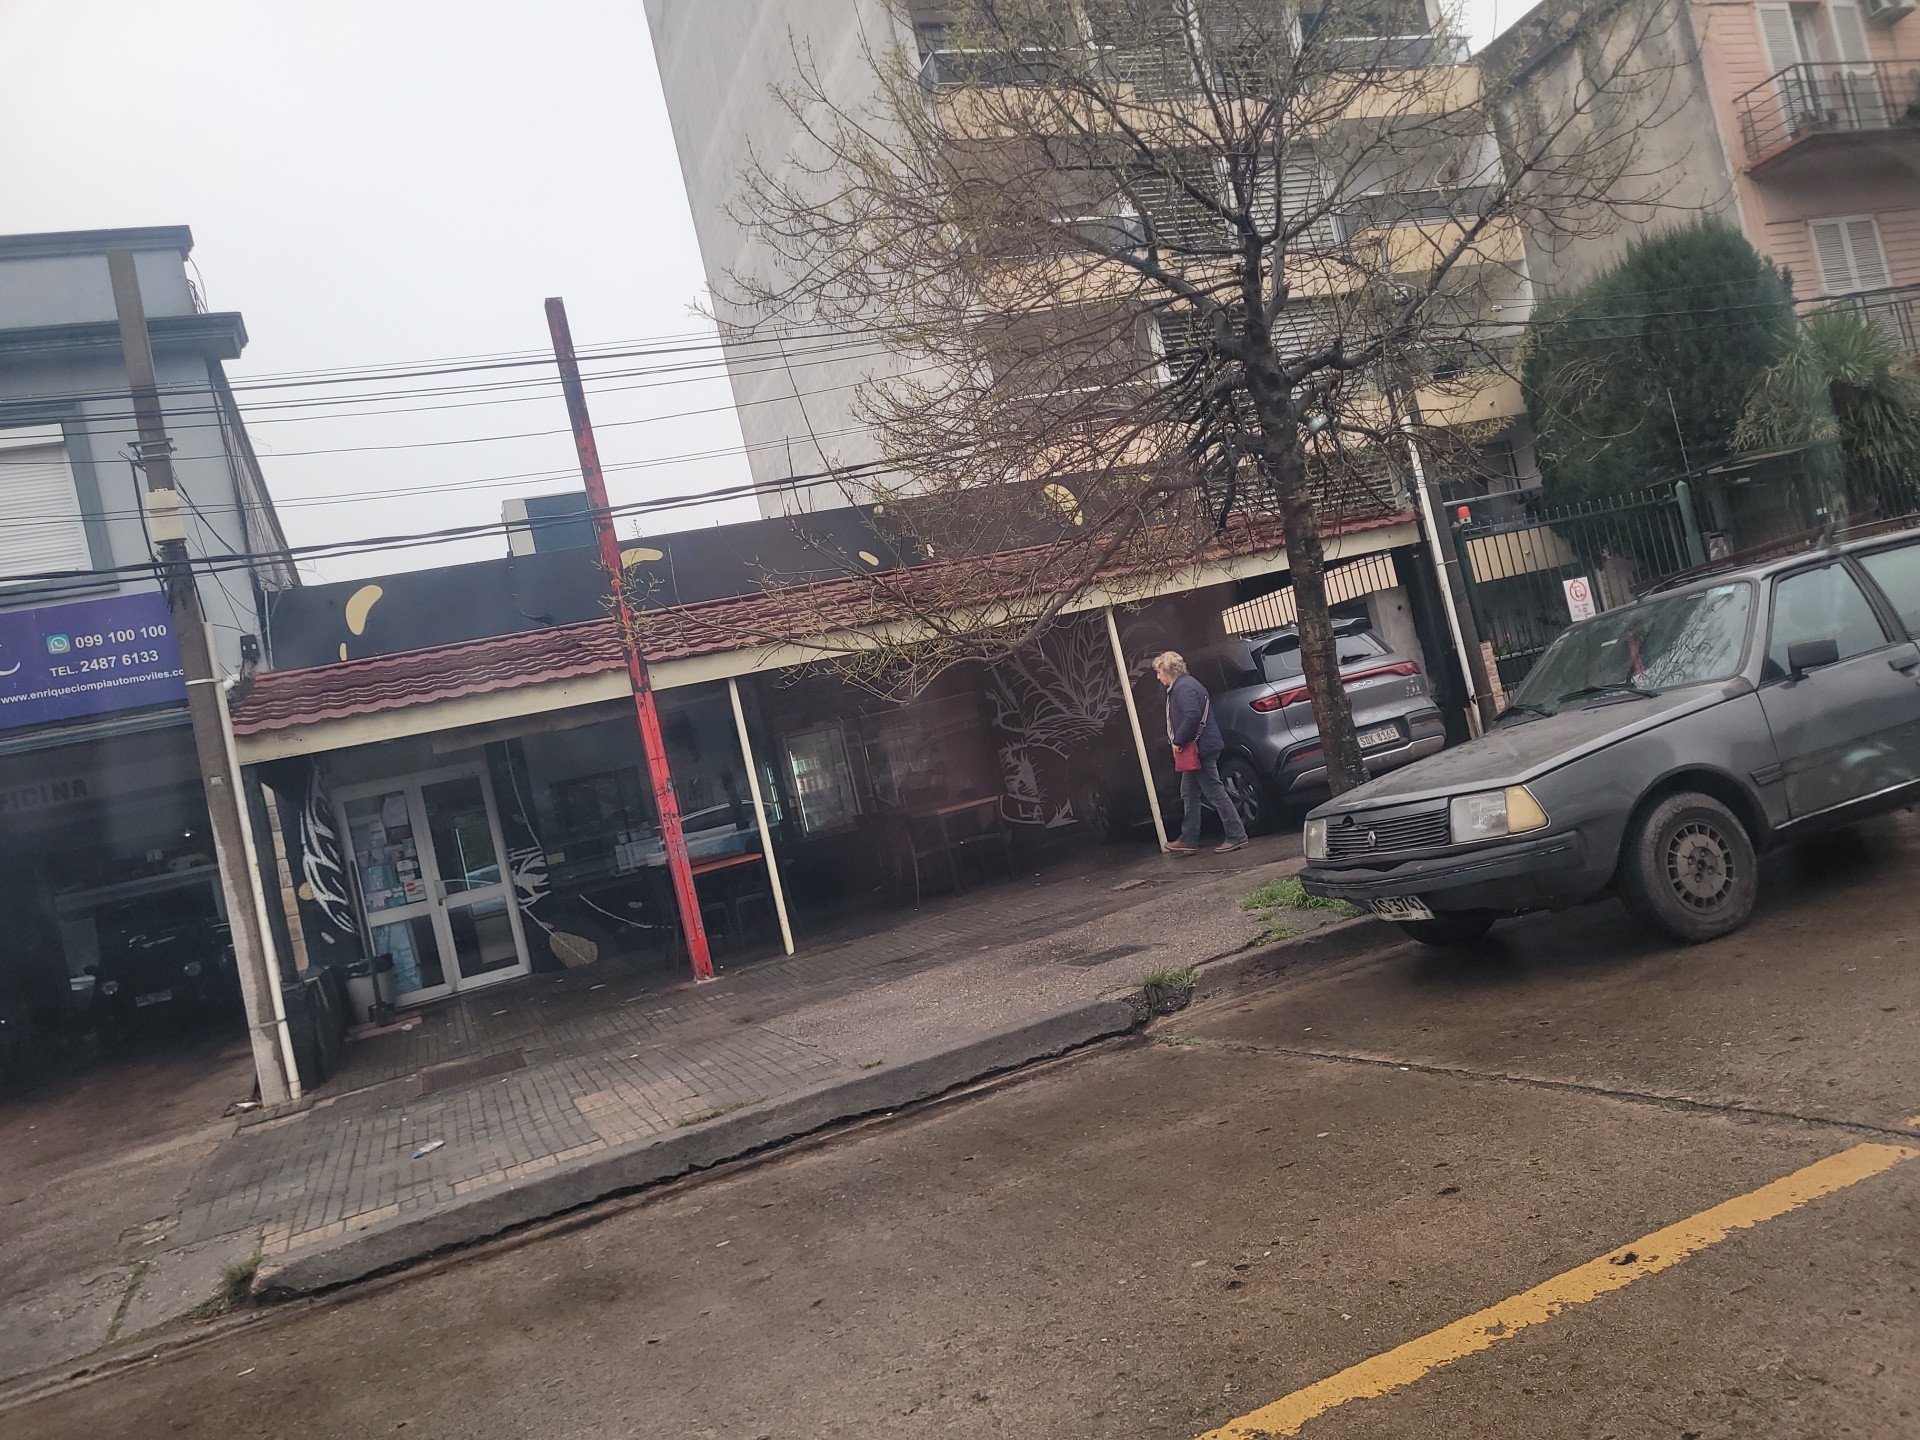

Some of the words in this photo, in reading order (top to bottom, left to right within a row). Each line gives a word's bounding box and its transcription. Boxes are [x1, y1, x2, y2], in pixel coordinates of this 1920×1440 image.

[75, 634, 104, 649] 099
[108, 629, 135, 644] 100
[140, 624, 167, 639] 100
[49, 665, 79, 678] TEL.
[80, 655, 117, 673] 2487
[122, 650, 159, 666] 6133
[1388, 896, 1427, 912] 3741
